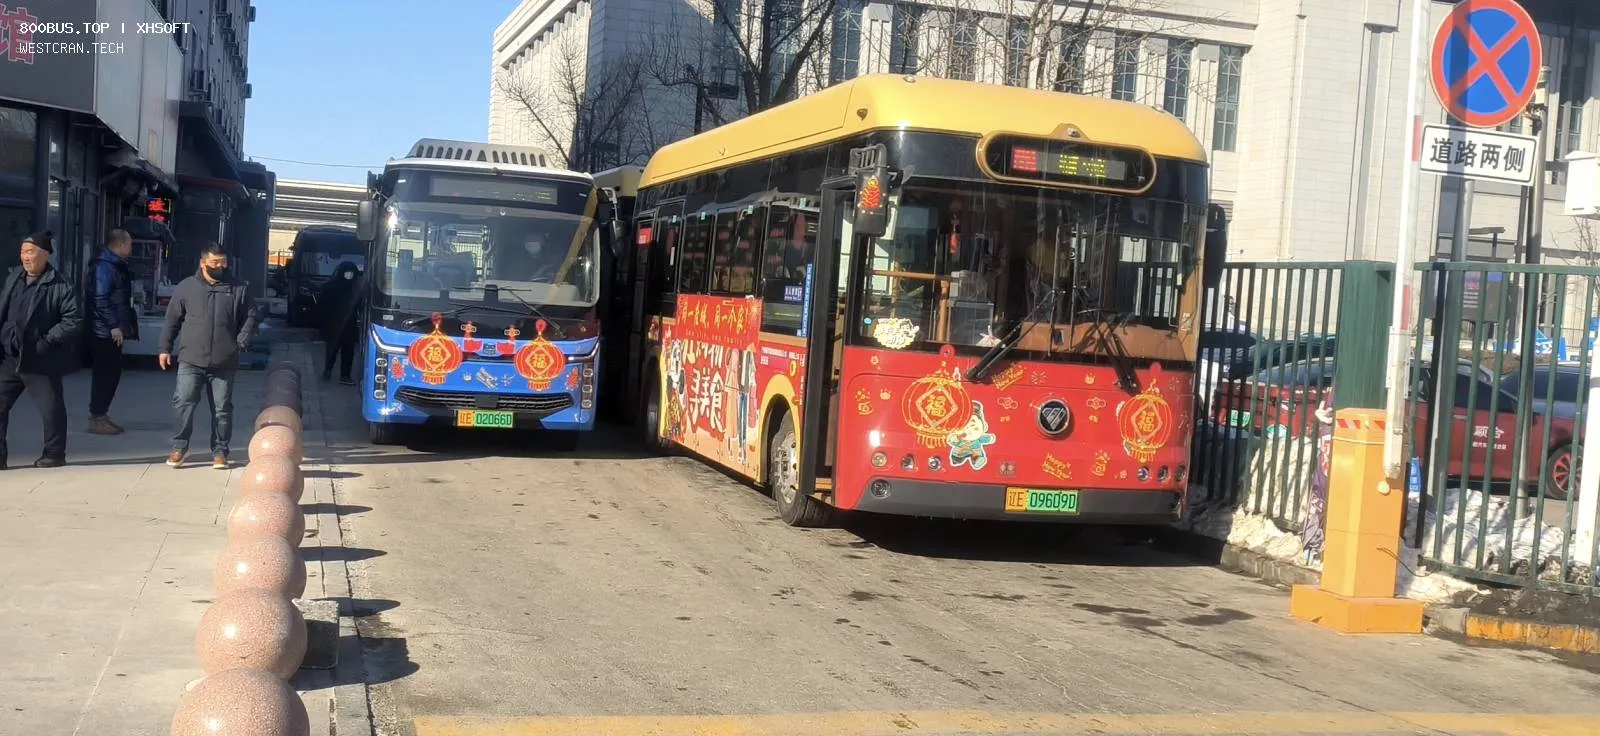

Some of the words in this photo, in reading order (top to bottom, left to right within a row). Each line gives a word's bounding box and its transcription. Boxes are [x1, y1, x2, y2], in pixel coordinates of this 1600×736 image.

[1430, 137, 1526, 173] 道路两侧
[428, 347, 442, 363] 福
[531, 353, 547, 369] 福
[925, 395, 947, 417] 福
[476, 412, 512, 425] 02066D
[1137, 410, 1155, 432] 福
[1029, 492, 1077, 509] 09609D
